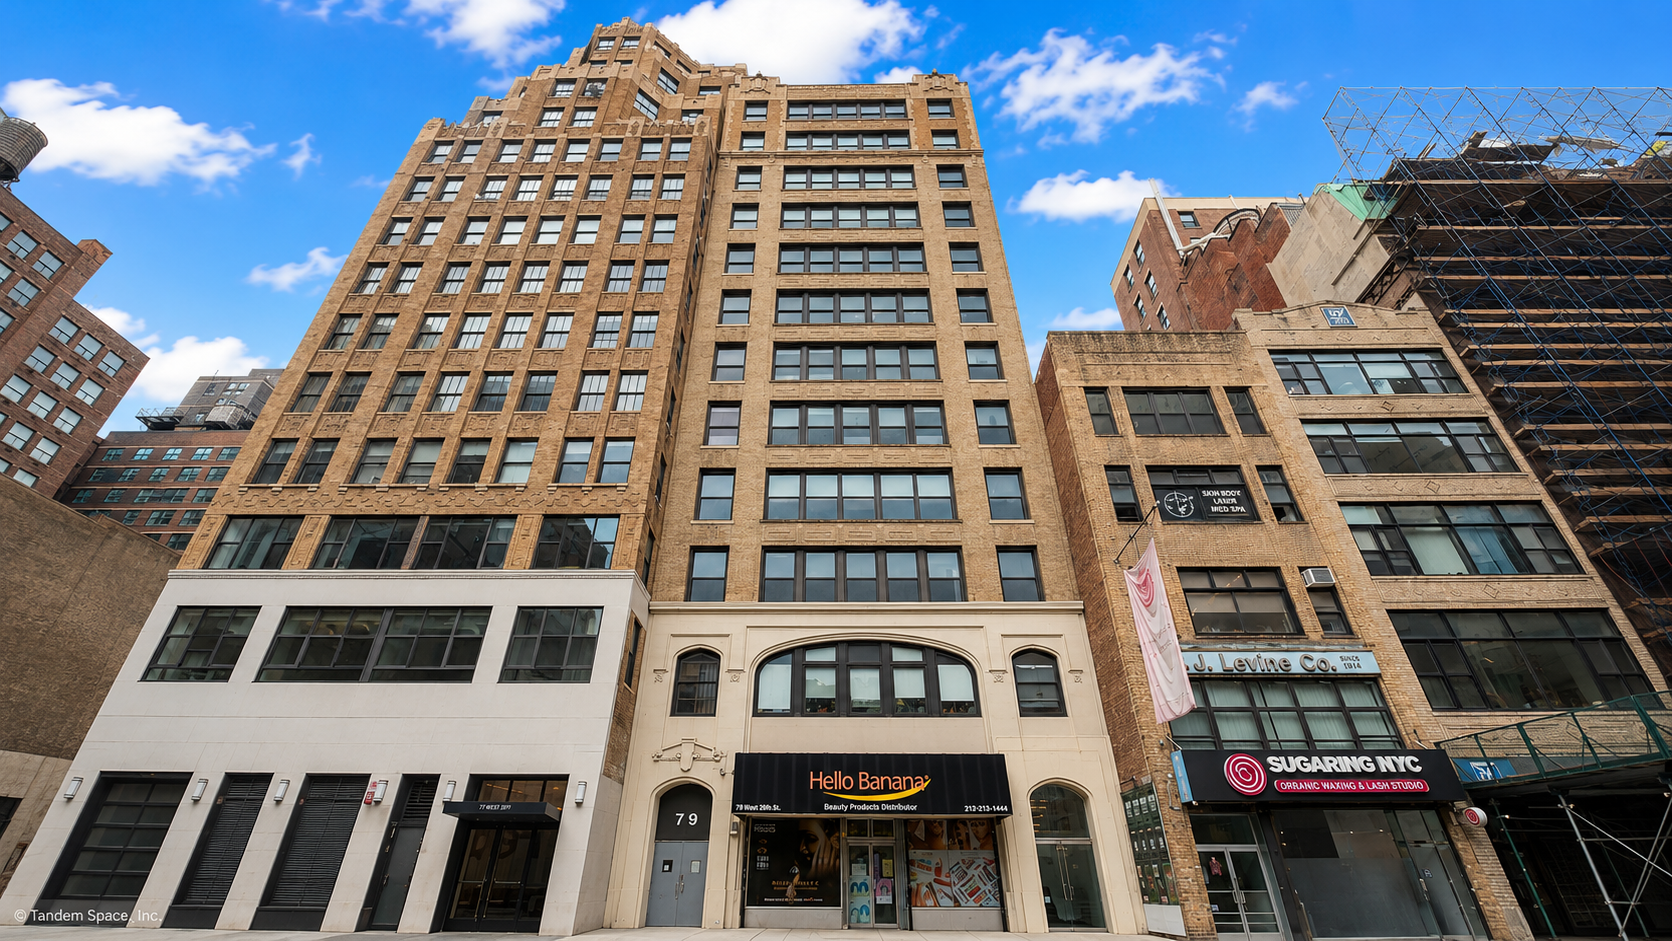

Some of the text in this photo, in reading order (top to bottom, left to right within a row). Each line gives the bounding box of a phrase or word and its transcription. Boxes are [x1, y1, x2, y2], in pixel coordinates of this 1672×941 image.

[1218, 653, 1292, 672] Levine
[1300, 653, 1338, 672] Co.
[1266, 755, 1423, 773] SUGARING NYC
[809, 770, 925, 791] Hello Banana
[1366, 781, 1390, 790] LASH
[1390, 781, 1424, 790] STUDIO
[824, 802, 918, 812] Beauty Products Distributor
[675, 813, 698, 826] 79
